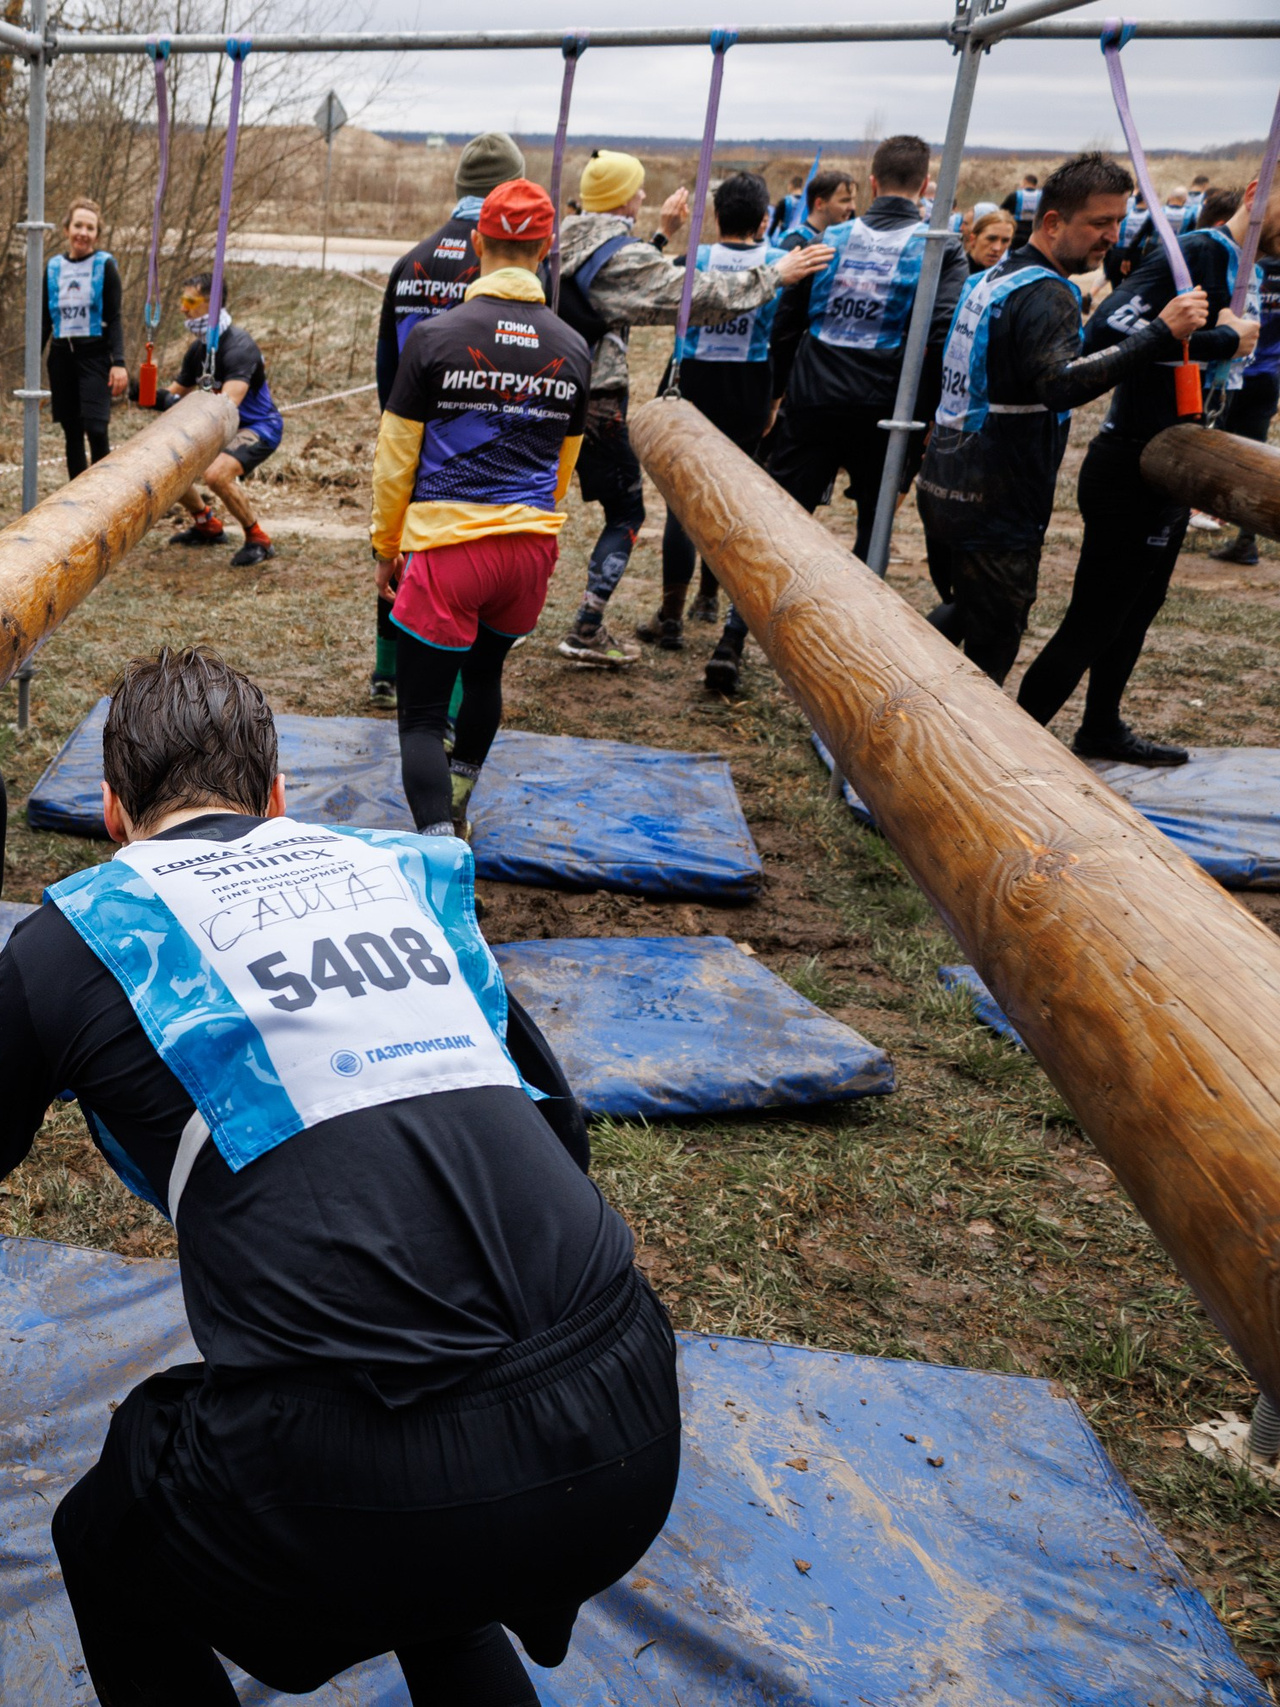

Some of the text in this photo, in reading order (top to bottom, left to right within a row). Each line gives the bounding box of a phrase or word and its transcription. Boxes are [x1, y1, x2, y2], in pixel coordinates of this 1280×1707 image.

[433, 249, 466, 260] ГЕРОЕВ
[440, 238, 467, 249] ГОНКА
[396, 280, 468, 299] ИНСТРУКТ
[830, 296, 881, 320] 5062
[497, 320, 536, 334] ГОНКА
[495, 333, 540, 349] ГЕРОЕВ
[441, 370, 577, 401] ИНСТРУКТОР
[437, 401, 498, 412] УВЕРЕННОСТЬ
[503, 405, 524, 415] СИЛА
[152, 835, 338, 873] ГОНКА ГЕРОЕВ
[211, 860, 349, 895] ПЕРФЕКЦИОНИСТЫ
[218, 862, 356, 904] FINE DEVELOPMENT
[208, 871, 384, 951] САША
[247, 927, 451, 1012] 5408
[365, 1035, 477, 1064] ГАЗПРОМБАНК
